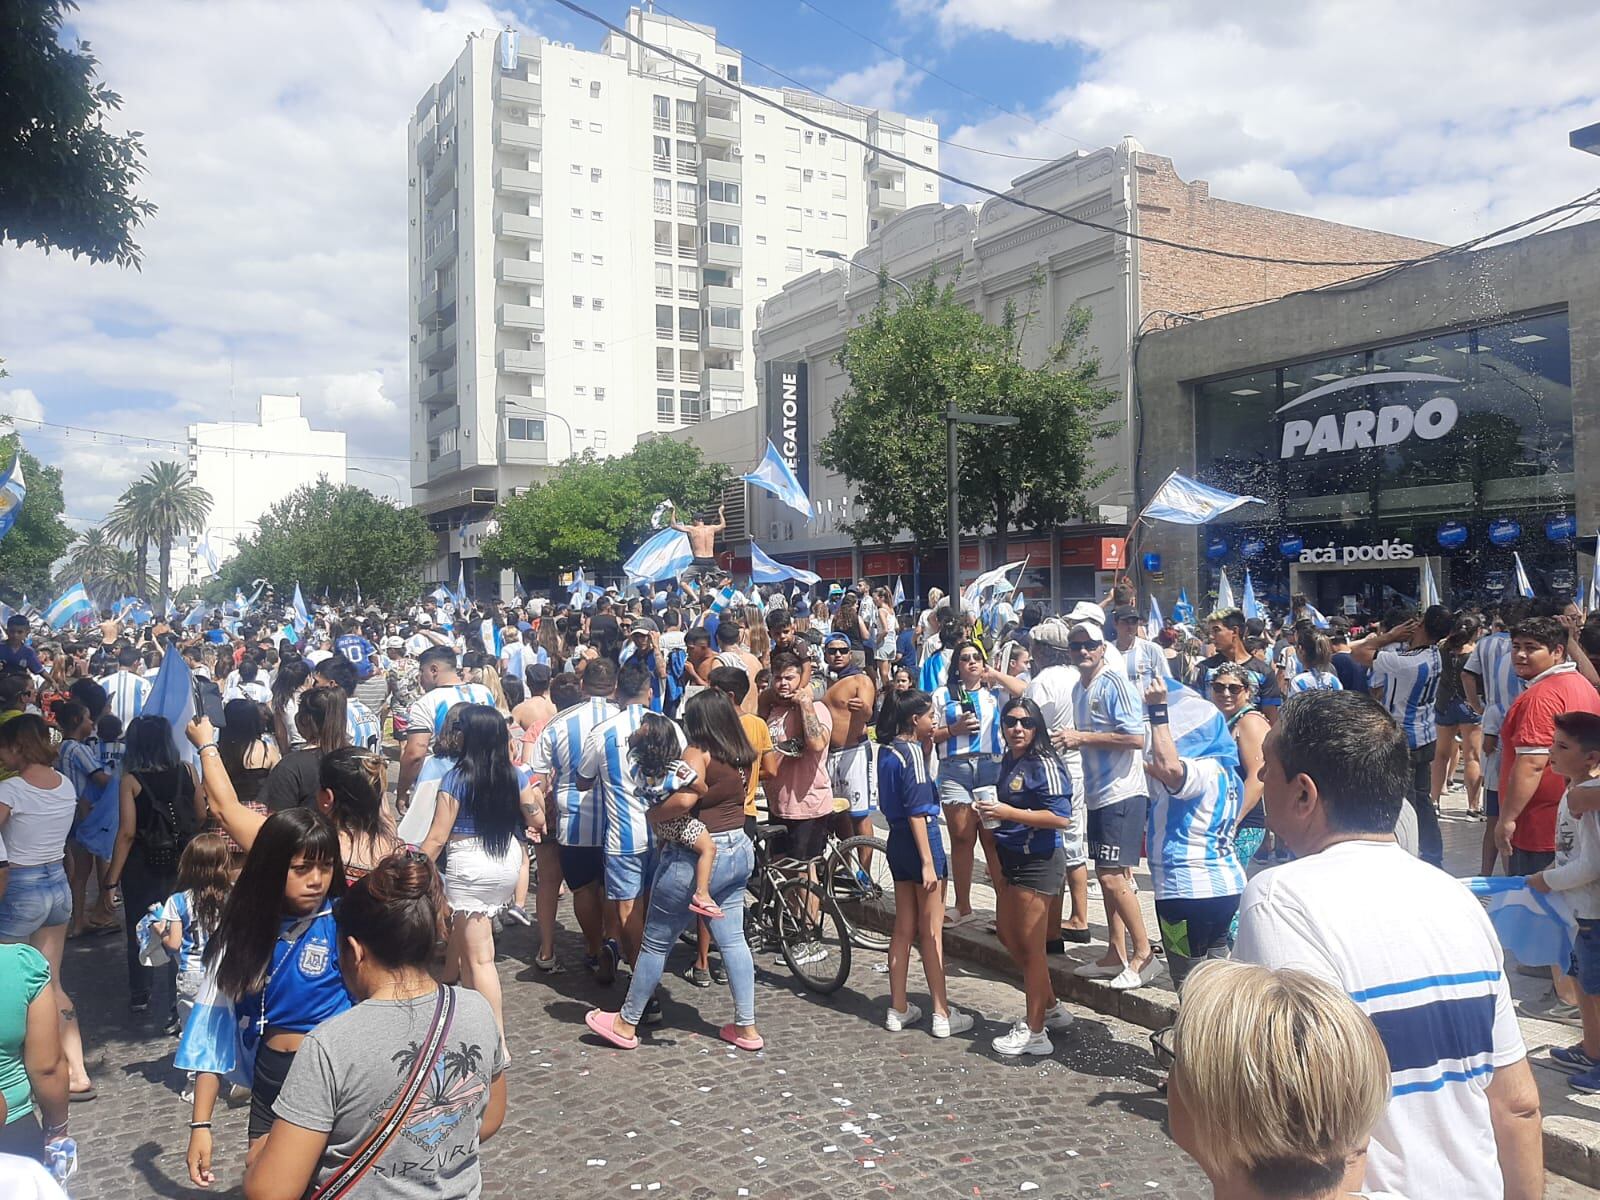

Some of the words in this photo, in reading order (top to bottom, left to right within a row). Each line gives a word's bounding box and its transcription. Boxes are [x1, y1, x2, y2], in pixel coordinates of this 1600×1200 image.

[782, 373, 798, 474] EGATONE
[1280, 397, 1458, 459] PARDO
[1299, 541, 1336, 563] acá
[1343, 537, 1414, 566] podés
[341, 645, 363, 663] 10
